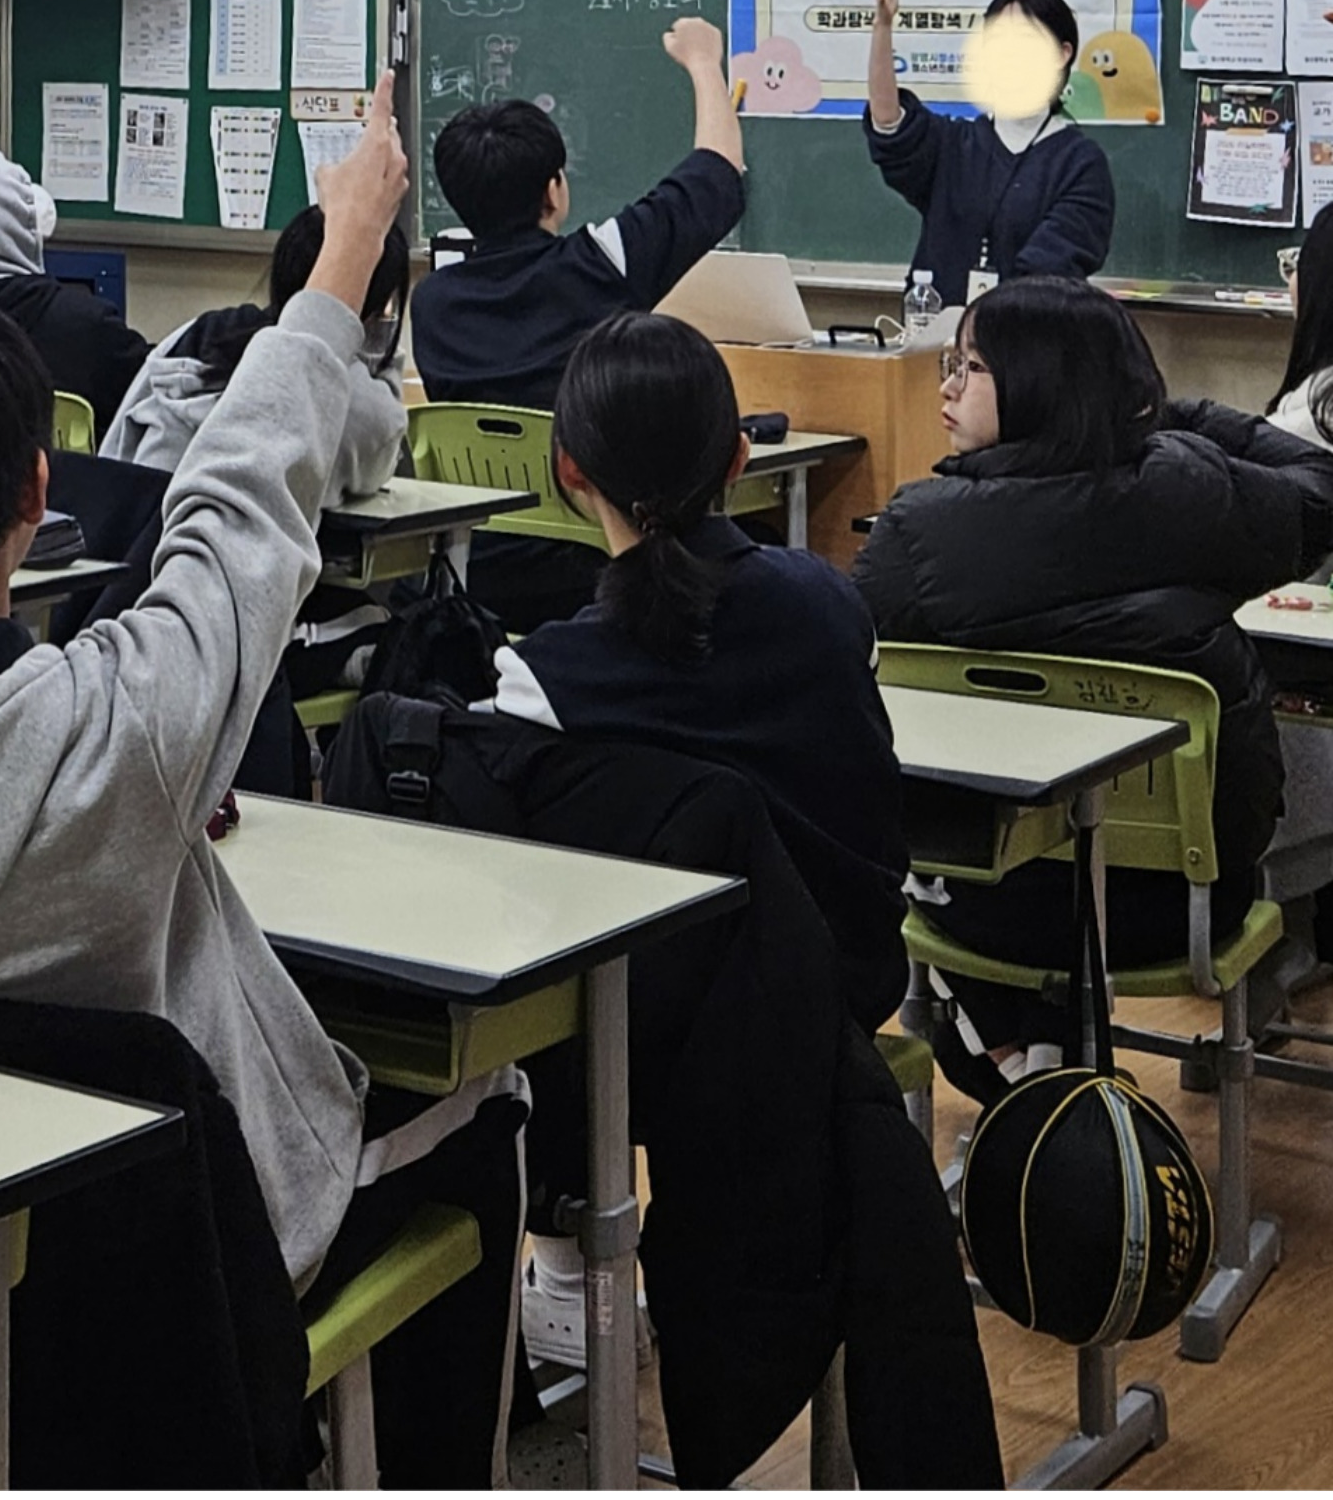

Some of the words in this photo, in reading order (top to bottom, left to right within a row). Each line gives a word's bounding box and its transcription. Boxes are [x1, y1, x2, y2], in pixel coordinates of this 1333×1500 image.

[897, 11, 962, 29] 계열탐색
[302, 96, 340, 113] 식단표
[1220, 102, 1280, 125] BAND
